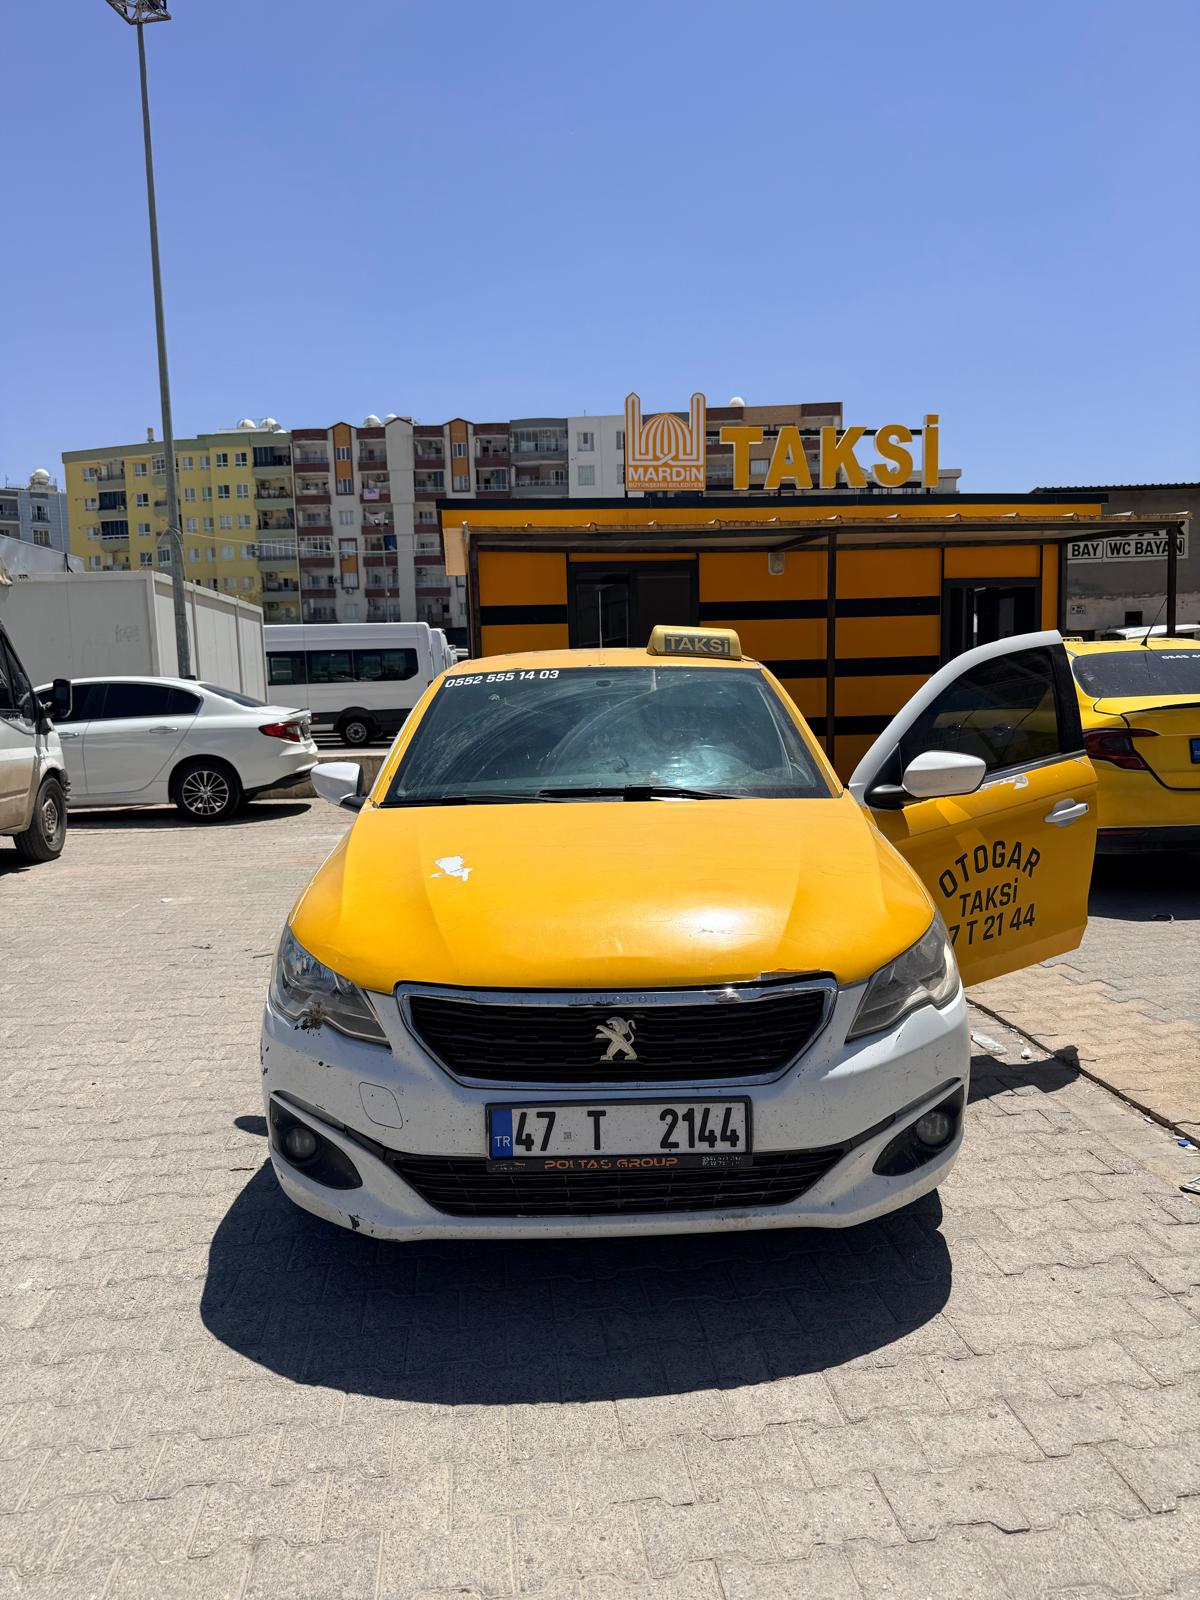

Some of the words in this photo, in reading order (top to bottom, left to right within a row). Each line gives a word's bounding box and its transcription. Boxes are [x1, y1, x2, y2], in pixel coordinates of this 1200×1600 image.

[1071, 544, 1099, 557] BAY
[1108, 542, 1131, 556] WC
[444, 675, 482, 688] 0552
[486, 672, 515, 683] 555
[519, 671, 535, 680] 14
[539, 670, 559, 679] 03
[939, 840, 1040, 898] OTOGAR
[966, 920, 978, 944] T
[515, 1111, 556, 1151] 47
[587, 1110, 607, 1151] T
[660, 1107, 740, 1149] 2144
[494, 1136, 511, 1147] TR
[616, 1157, 678, 1168] GROUP
